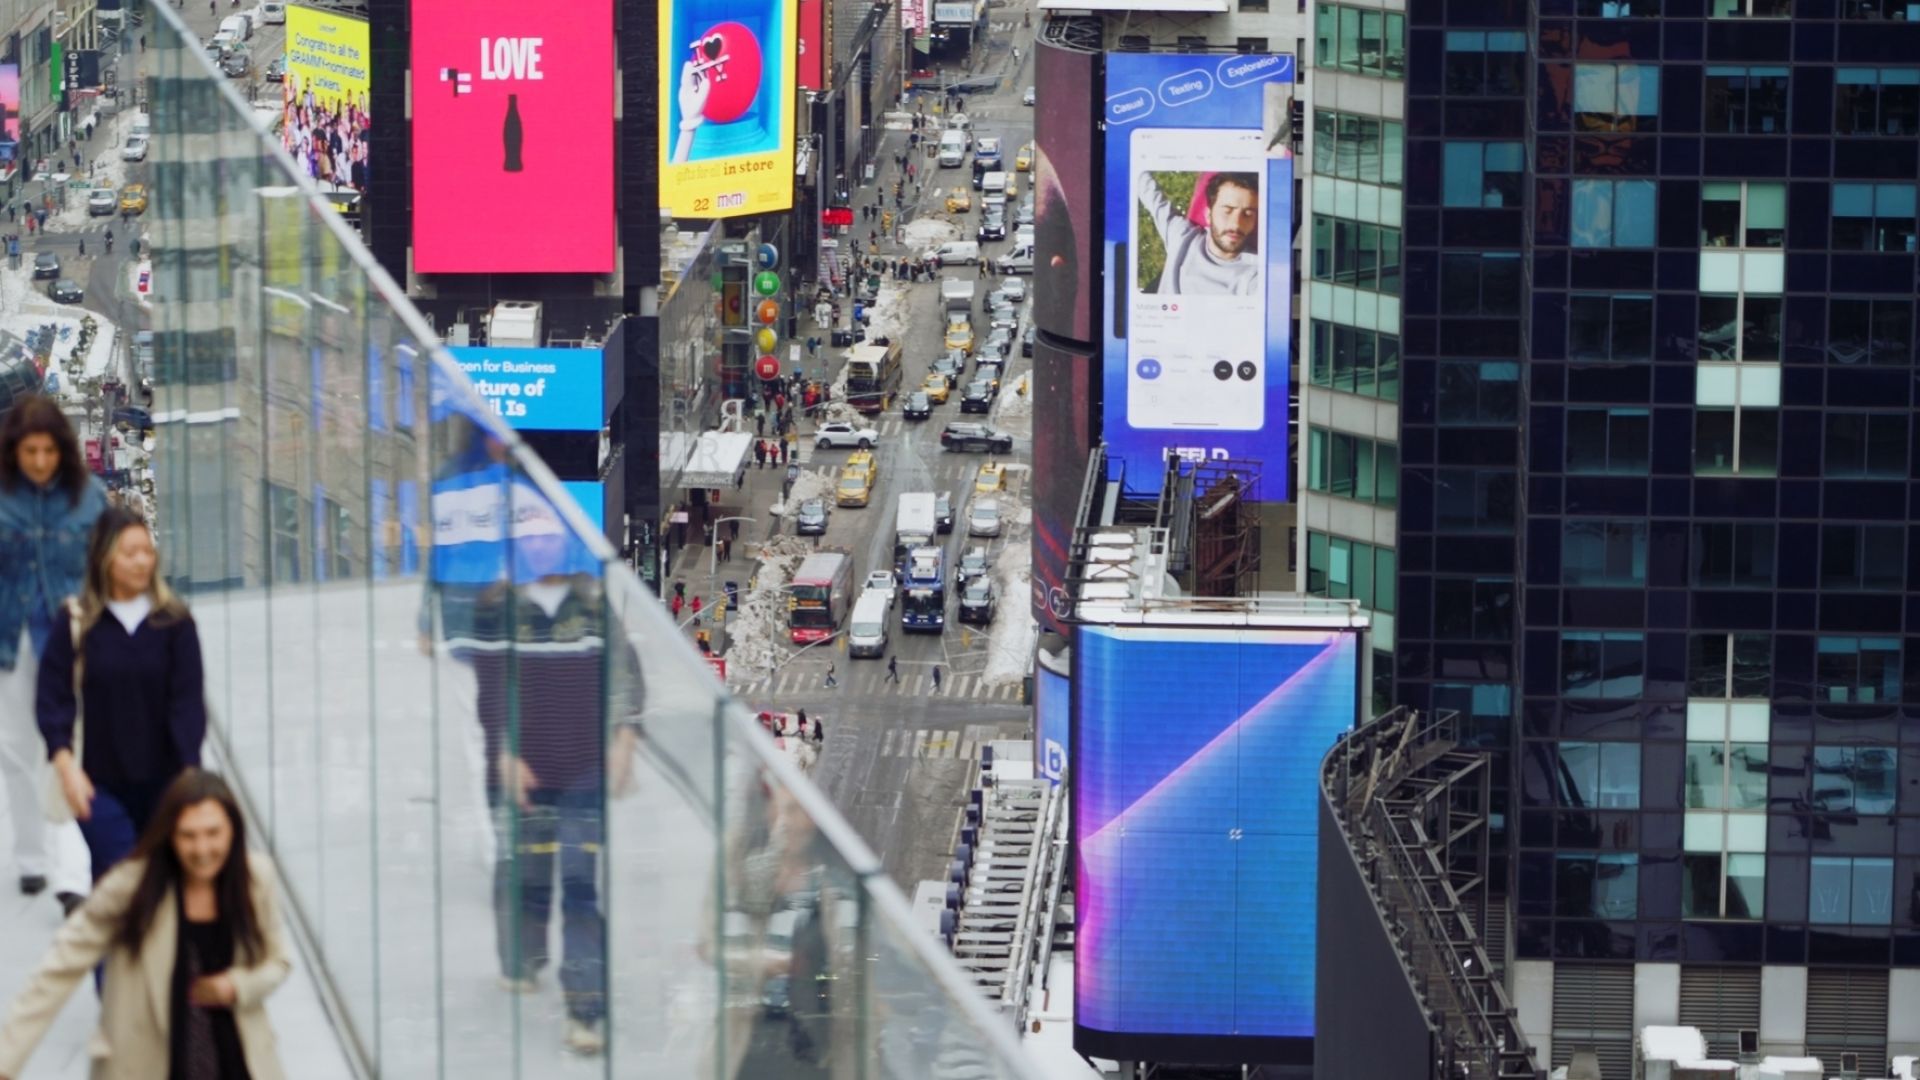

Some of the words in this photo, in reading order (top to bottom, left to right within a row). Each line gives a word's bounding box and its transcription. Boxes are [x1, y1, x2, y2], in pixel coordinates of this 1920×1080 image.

[481, 37, 543, 80] LOVE
[1227, 56, 1279, 79] Exploration
[1168, 79, 1204, 97] Texting
[1112, 97, 1145, 115] Casual
[724, 162, 736, 176] in
[740, 160, 774, 173] store
[694, 198, 710, 212] 22
[762, 280, 773, 290] m
[483, 360, 501, 373] for
[503, 361, 557, 374] Business
[763, 363, 774, 373] m
[471, 379, 521, 397] uture
[524, 378, 546, 396] of
[505, 400, 527, 417] Is
